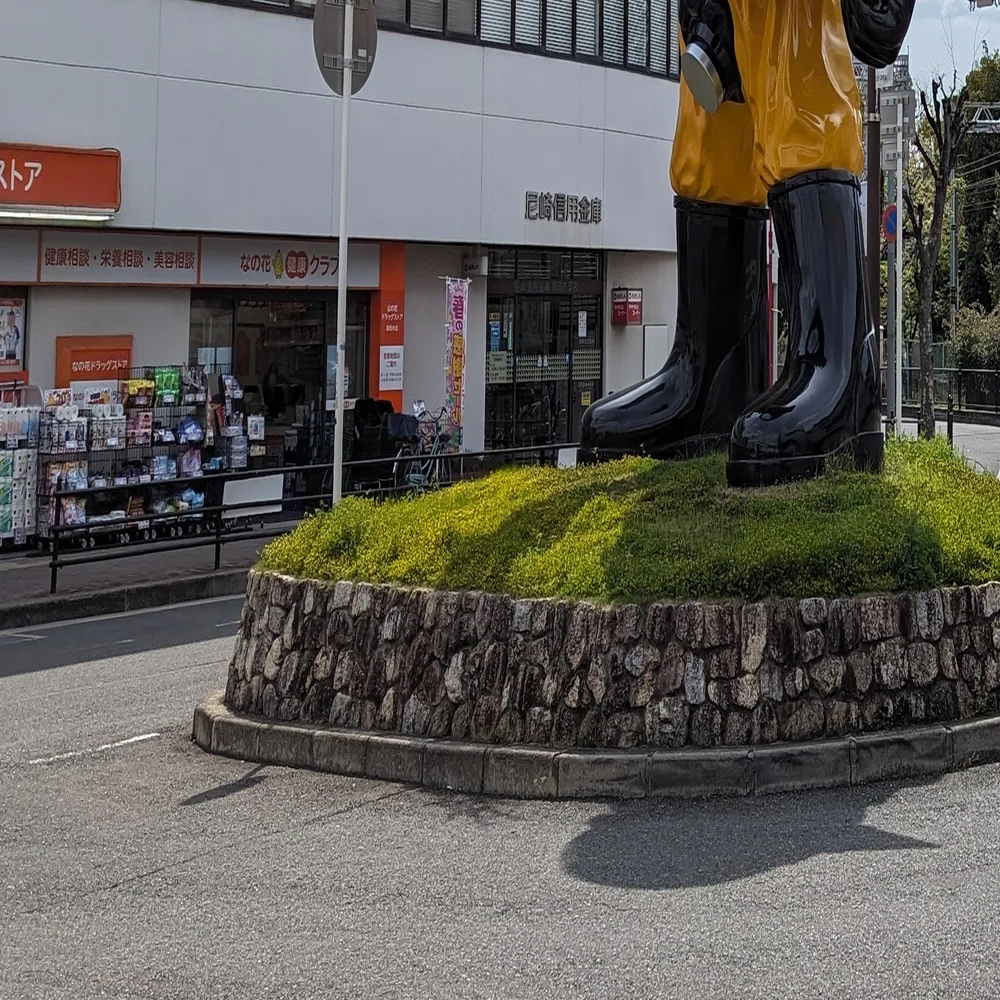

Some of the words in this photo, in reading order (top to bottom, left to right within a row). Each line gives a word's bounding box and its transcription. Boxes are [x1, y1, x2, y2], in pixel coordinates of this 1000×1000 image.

[524, 190, 603, 225] 尼崎信用金庫
[240, 253, 272, 273] なの花
[71, 360, 129, 372] なの花ドラッグストア
